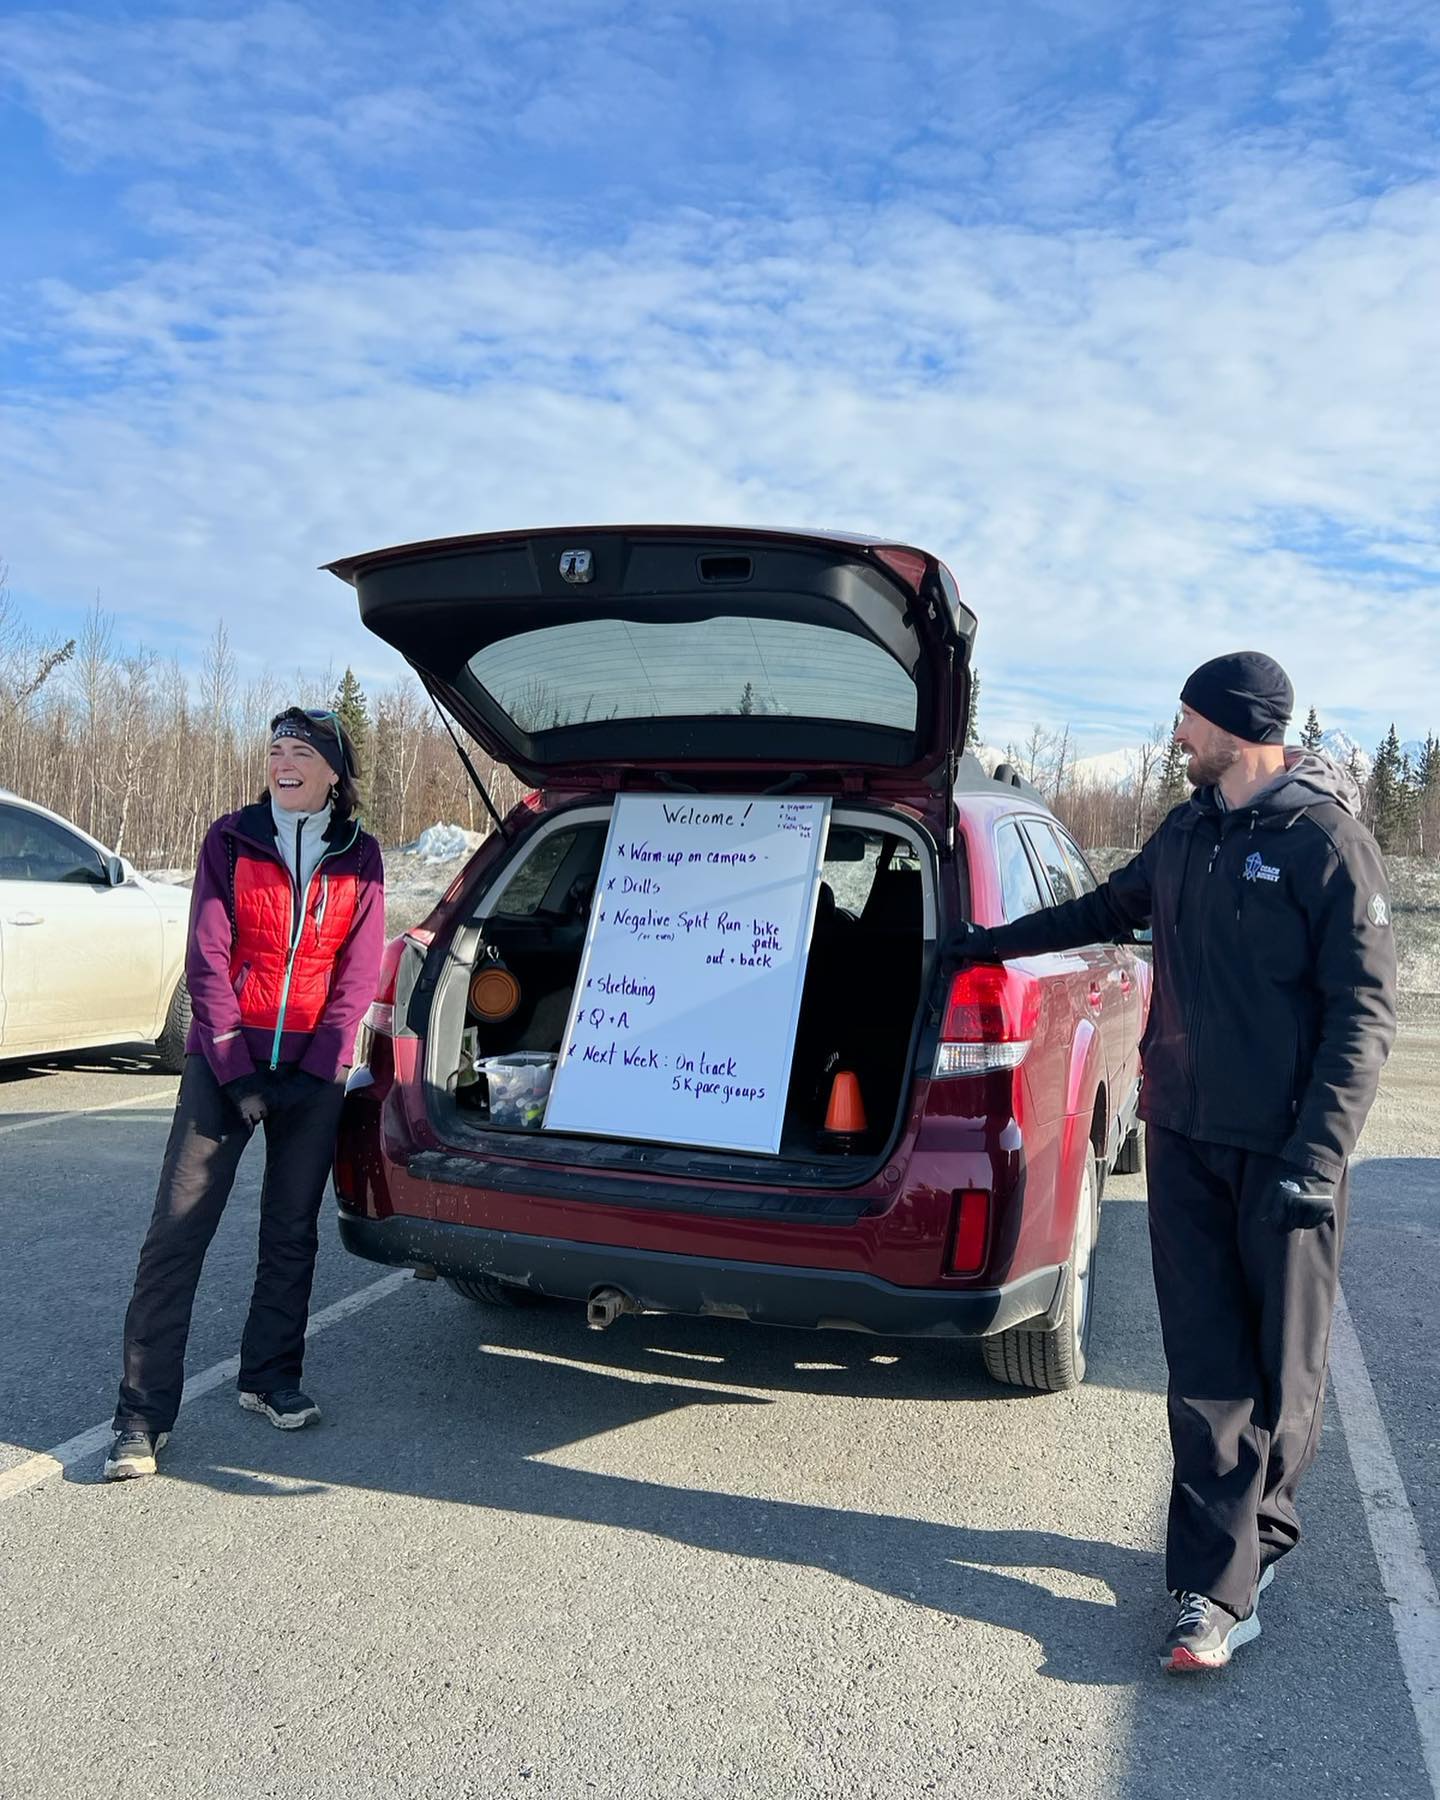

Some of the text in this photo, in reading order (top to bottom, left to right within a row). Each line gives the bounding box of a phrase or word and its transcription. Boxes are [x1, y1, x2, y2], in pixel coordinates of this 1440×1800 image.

[688, 852, 702, 863] on
[707, 852, 757, 867] campus
[621, 875, 661, 894] Drills
[613, 909, 670, 933] Negative
[677, 912, 710, 932] Split
[717, 913, 741, 933] Run
[752, 919, 780, 937] bike
[752, 936, 782, 955] path
[706, 949, 724, 965] out
[740, 950, 772, 968] back
[597, 973, 656, 1005] Stretching
[589, 1008, 605, 1028] Q
[617, 1012, 629, 1028] A
[583, 1042, 617, 1065] Next
[676, 1052, 694, 1072] On
[700, 1052, 737, 1077] track
[694, 1079, 721, 1099] pace
[721, 1082, 766, 1104] groups
